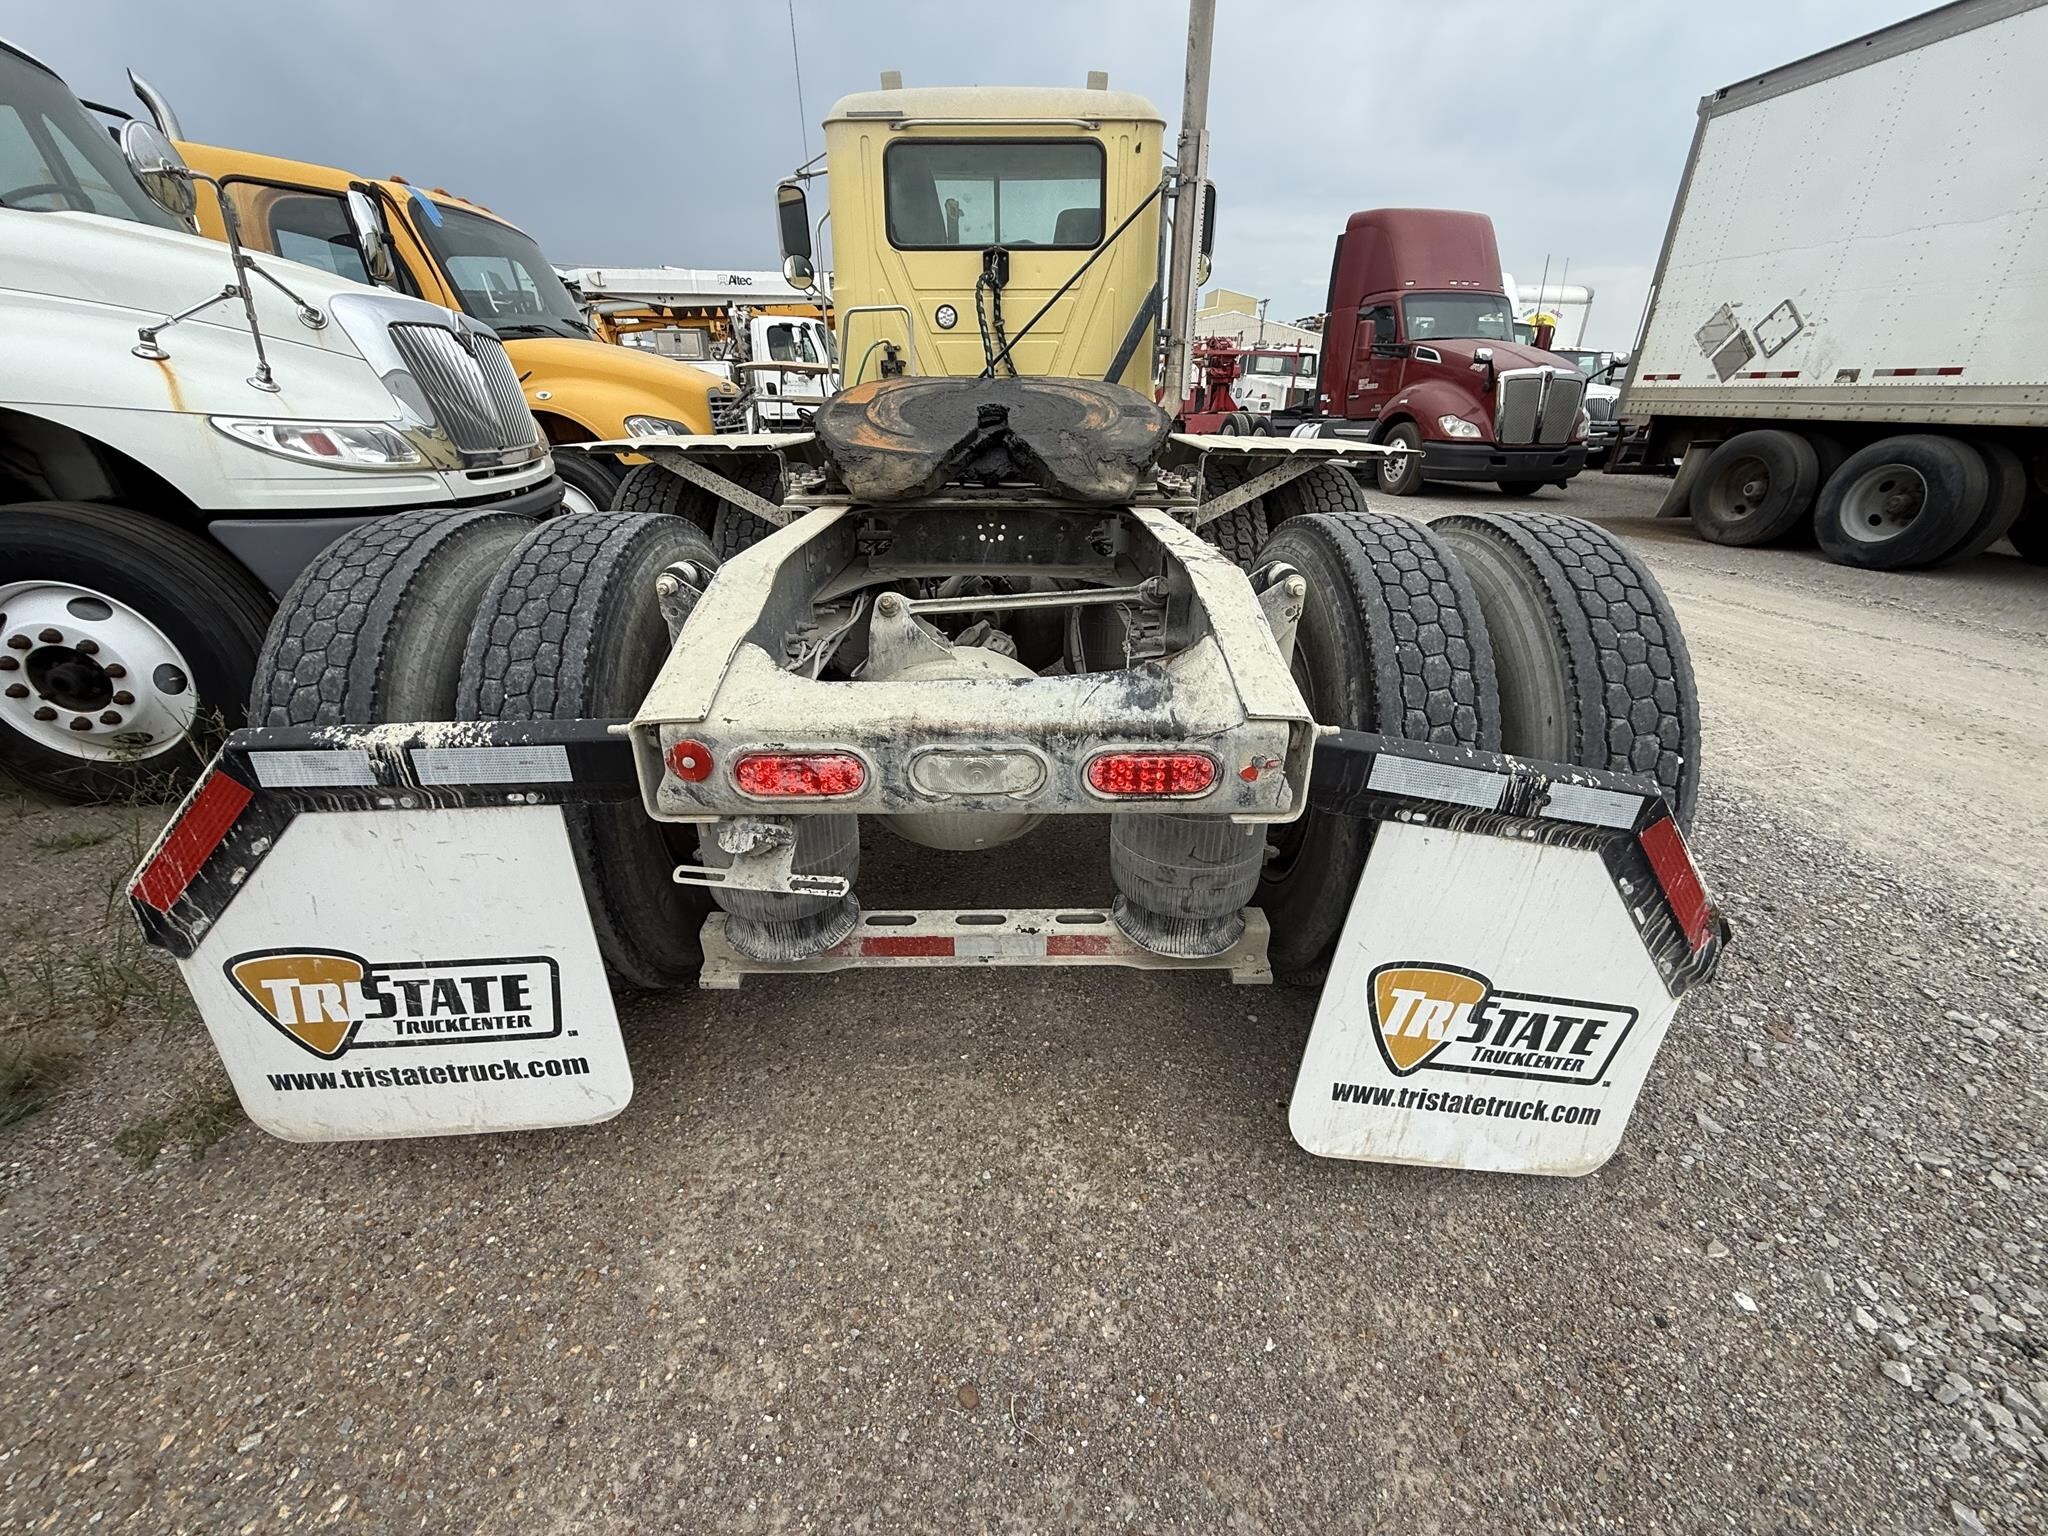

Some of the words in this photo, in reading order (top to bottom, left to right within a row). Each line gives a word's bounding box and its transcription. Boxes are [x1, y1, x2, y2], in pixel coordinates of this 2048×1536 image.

[729, 275, 752, 285] Altec
[266, 1056, 590, 1091] www.tristatetruck.com
[1331, 1082, 1601, 1126] www.tristatetruck.com
